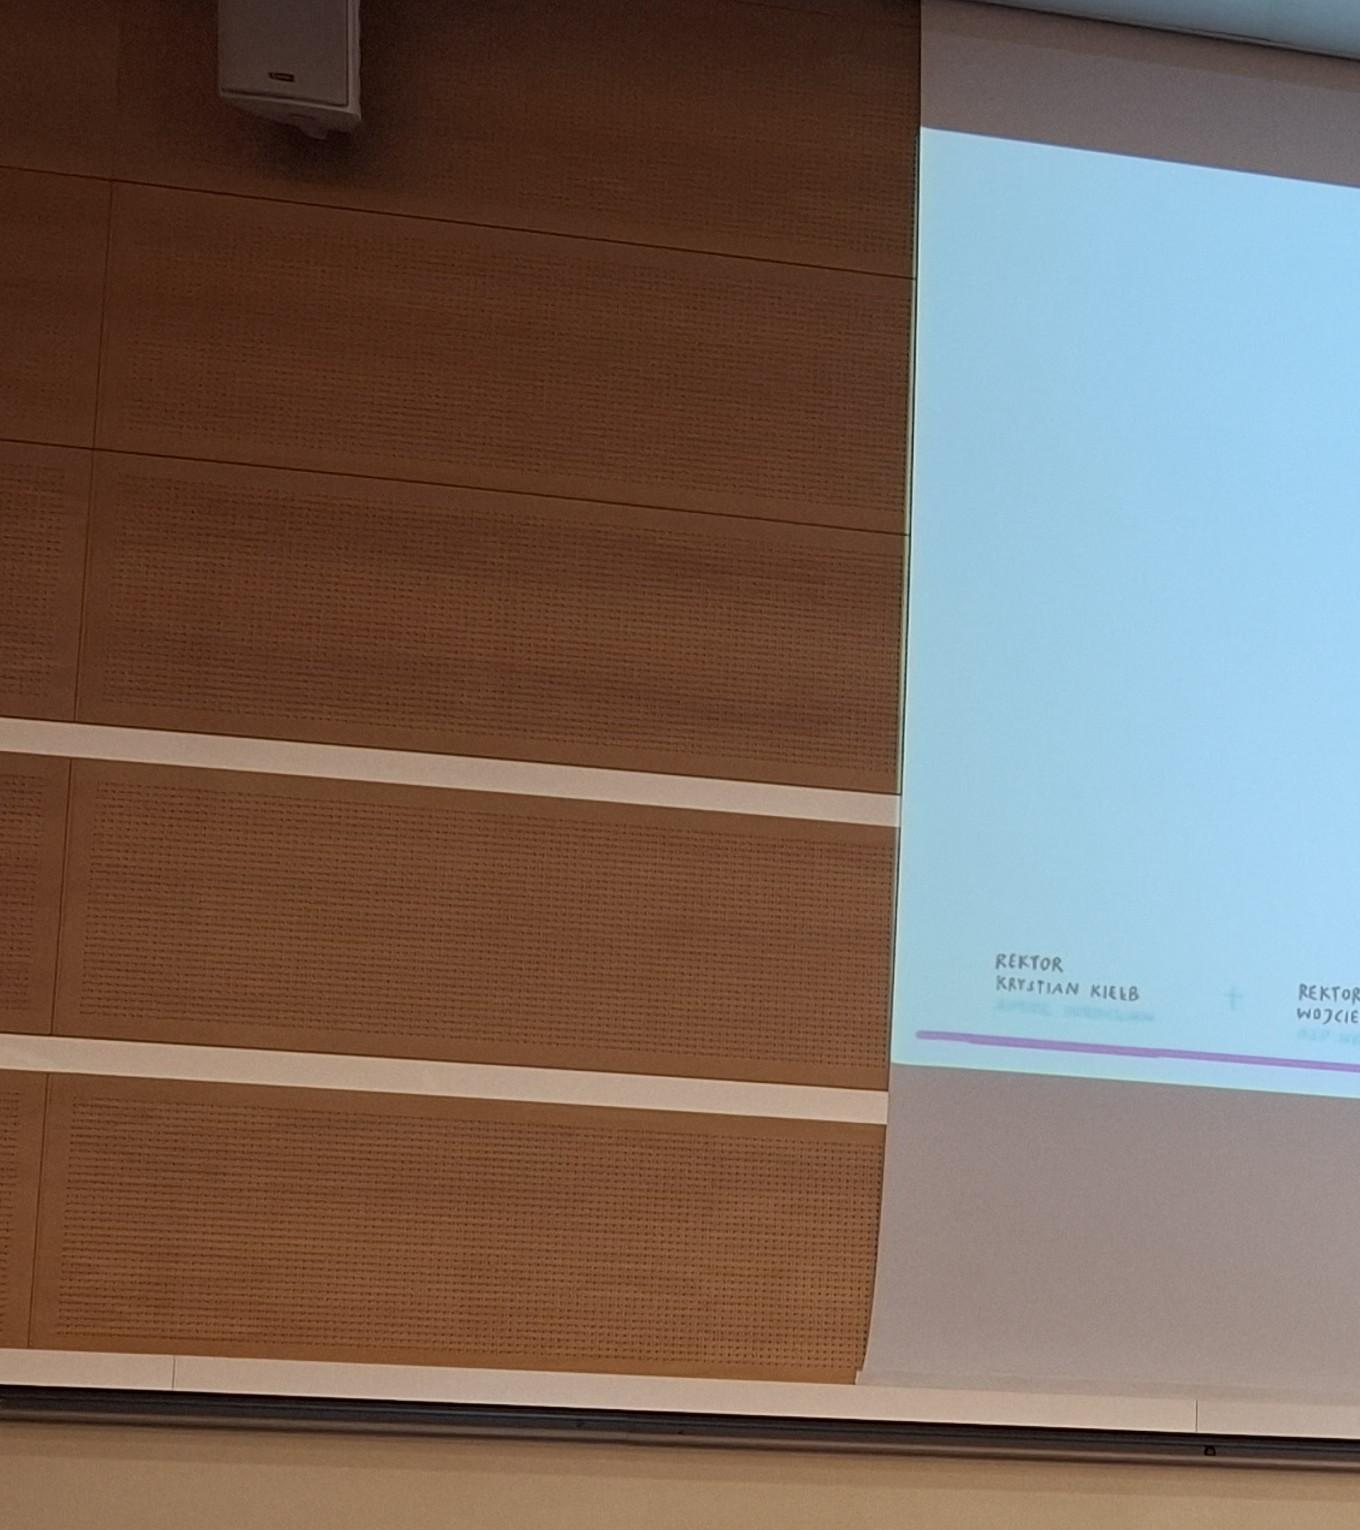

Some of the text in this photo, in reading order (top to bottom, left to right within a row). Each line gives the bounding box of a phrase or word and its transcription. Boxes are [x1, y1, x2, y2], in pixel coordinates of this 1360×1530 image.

[995, 953, 1064, 973] REKTOR
[995, 975, 1140, 1001] KRYSTIAN KIEŁB
